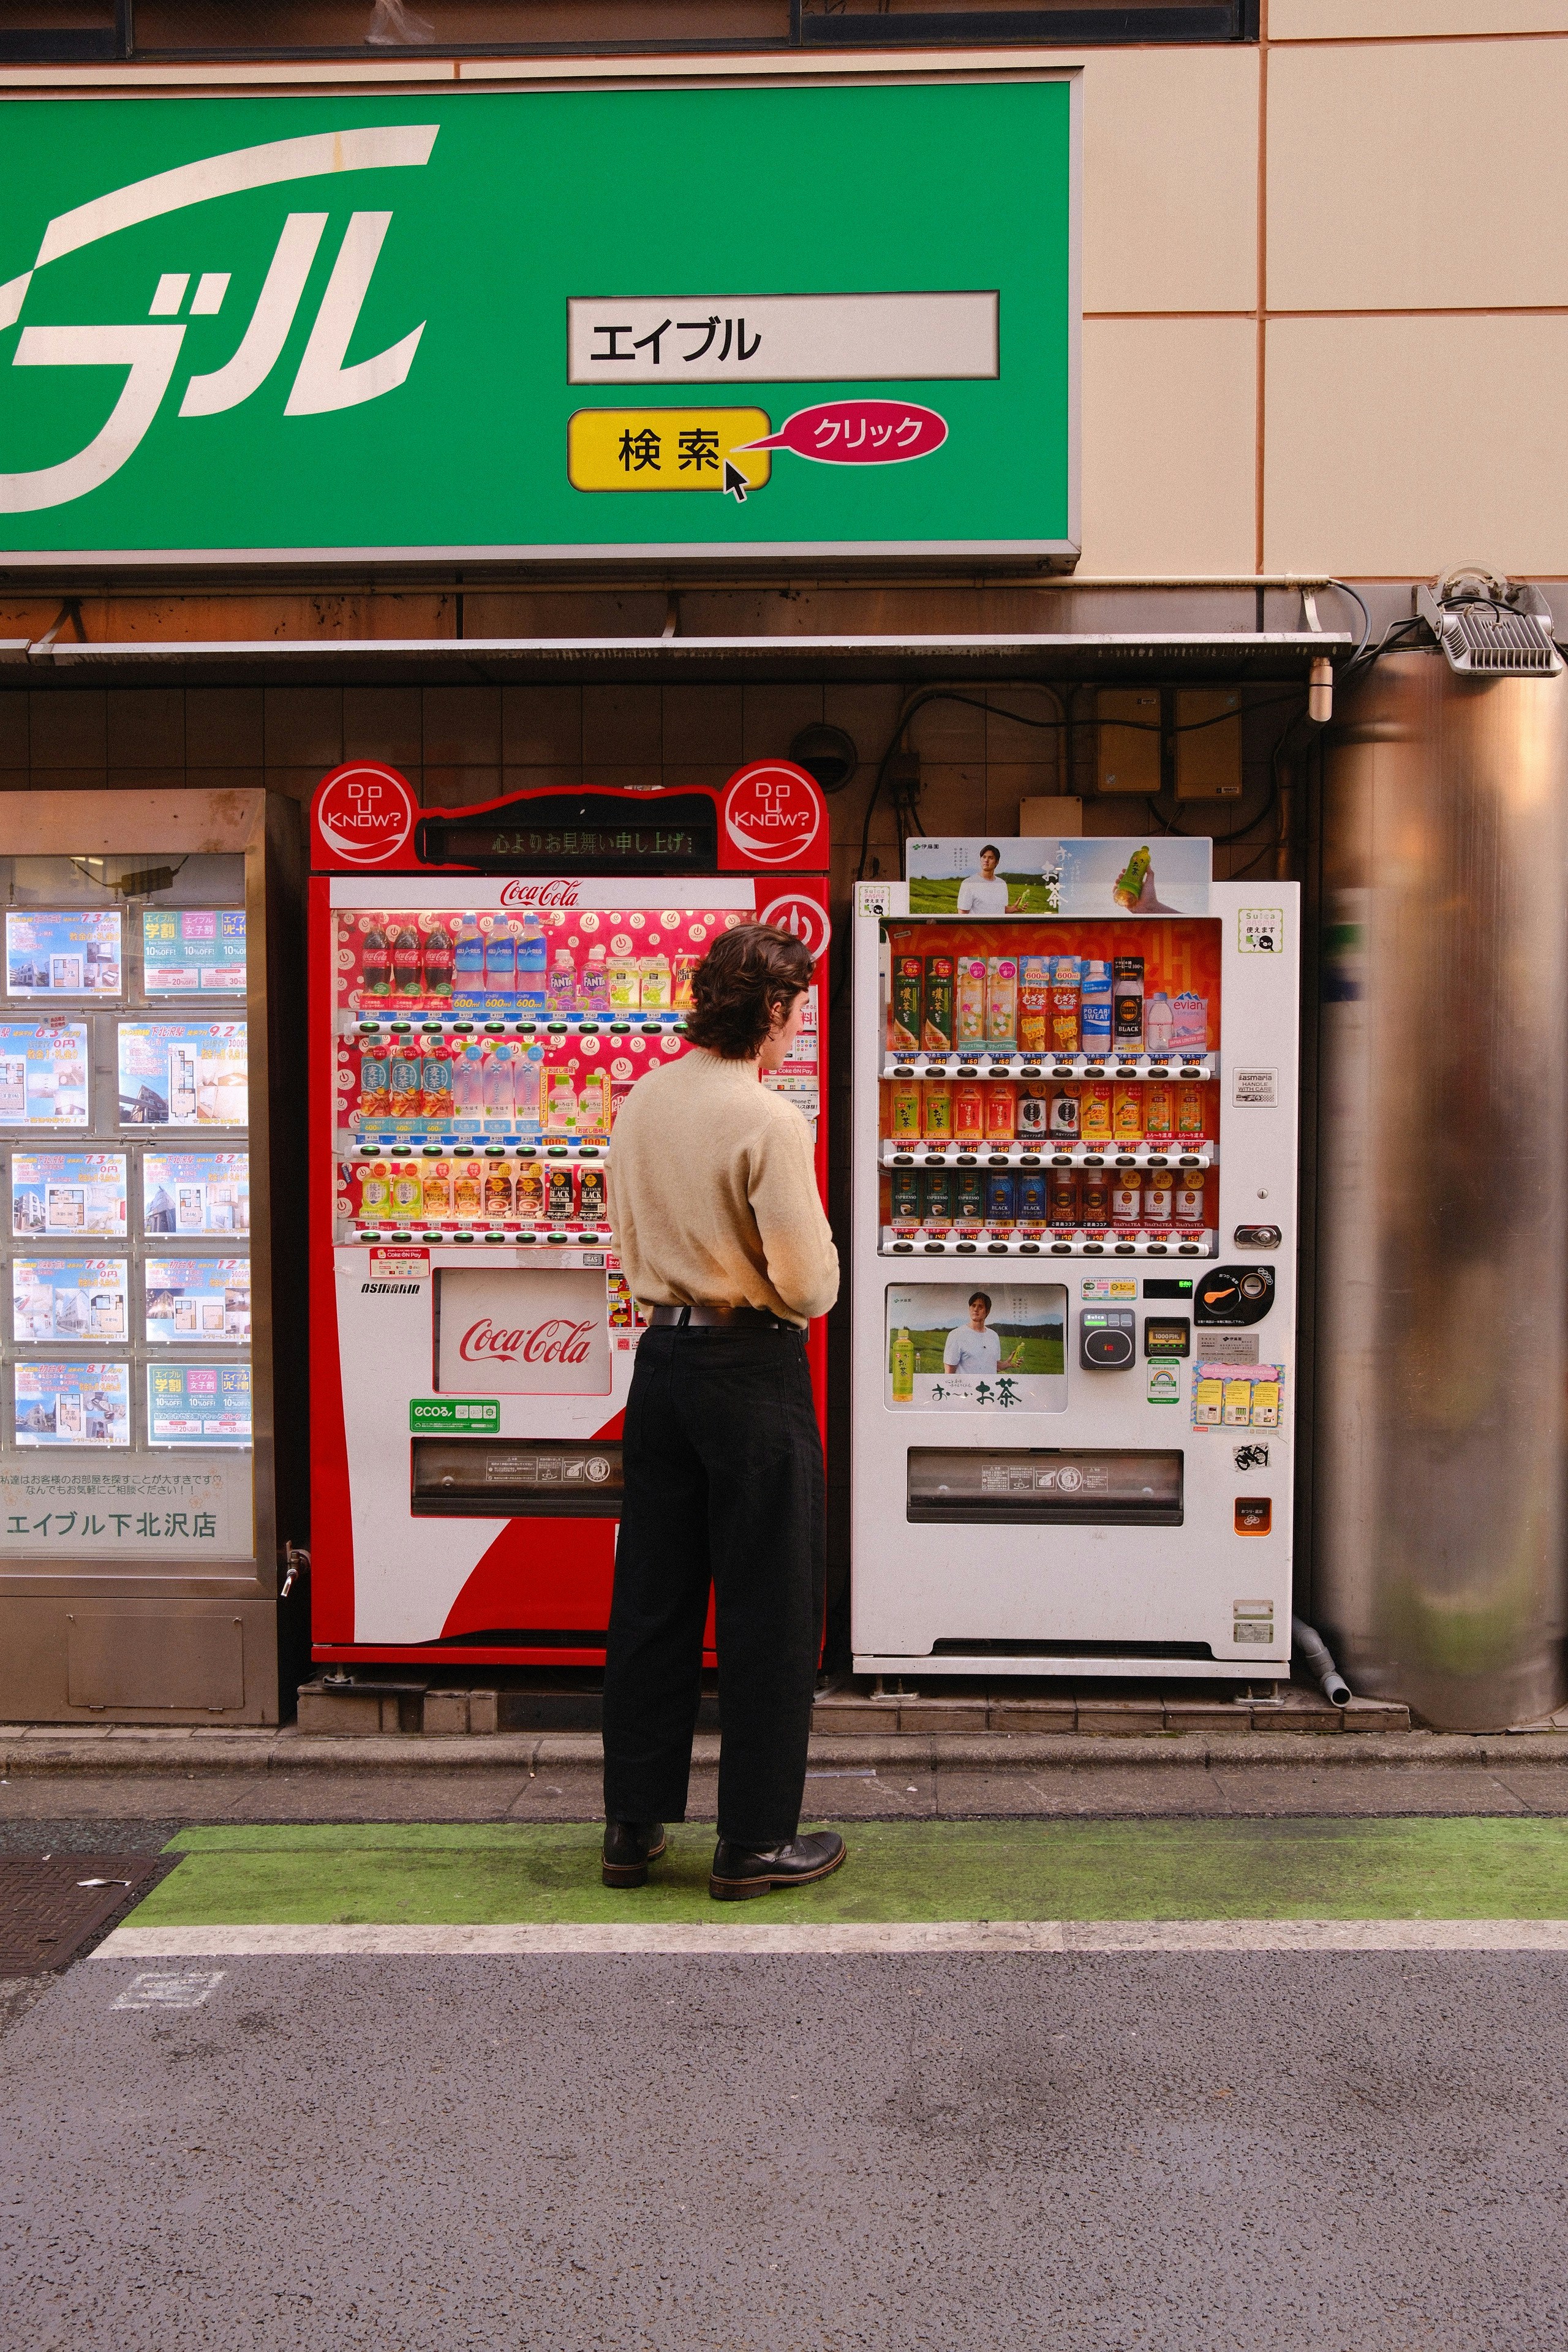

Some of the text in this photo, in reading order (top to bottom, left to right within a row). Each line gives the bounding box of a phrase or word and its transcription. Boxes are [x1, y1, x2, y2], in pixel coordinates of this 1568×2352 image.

[590, 315, 762, 364] エイブル
[813, 417, 923, 448] クリック
[618, 428, 720, 471] 検索
[328, 812, 402, 827] KNOW?
[734, 812, 810, 827] KNOW?
[492, 832, 692, 854] 心よりお見舞い申し上げ
[500, 880, 583, 907] Coca-Cola
[145, 923, 175, 938] 学割
[186, 925, 213, 935] 女子割
[456, 946, 480, 956] AQUARIUS
[488, 946, 511, 956] AQUARIUS
[519, 946, 542, 956] AQUARIUS
[551, 978, 572, 987] FANTA
[584, 976, 606, 987] FANTA
[1022, 995, 1046, 1005] むぎ茶
[1054, 994, 1077, 1005] むぎ茶
[1174, 1000, 1203, 1010] evian
[151, 1027, 185, 1037] 下北沢駅
[209, 1026, 235, 1037] 9.2
[368, 1066, 378, 1087] 麦茶
[398, 1066, 408, 1087] 麦茶
[38, 1155, 65, 1164] 下北沢駅
[85, 1155, 105, 1164] 7.3
[167, 1155, 195, 1164] 下北沢駅
[215, 1155, 235, 1164] 8.2
[85, 1261, 106, 1269] 7.6
[169, 1261, 196, 1269] 初台駅
[459, 1318, 599, 1363] Coca-Cola
[86, 1365, 106, 1373] 8.1
[155, 1379, 181, 1392] 学割
[7, 1511, 217, 1537] エイブル下北沢店
